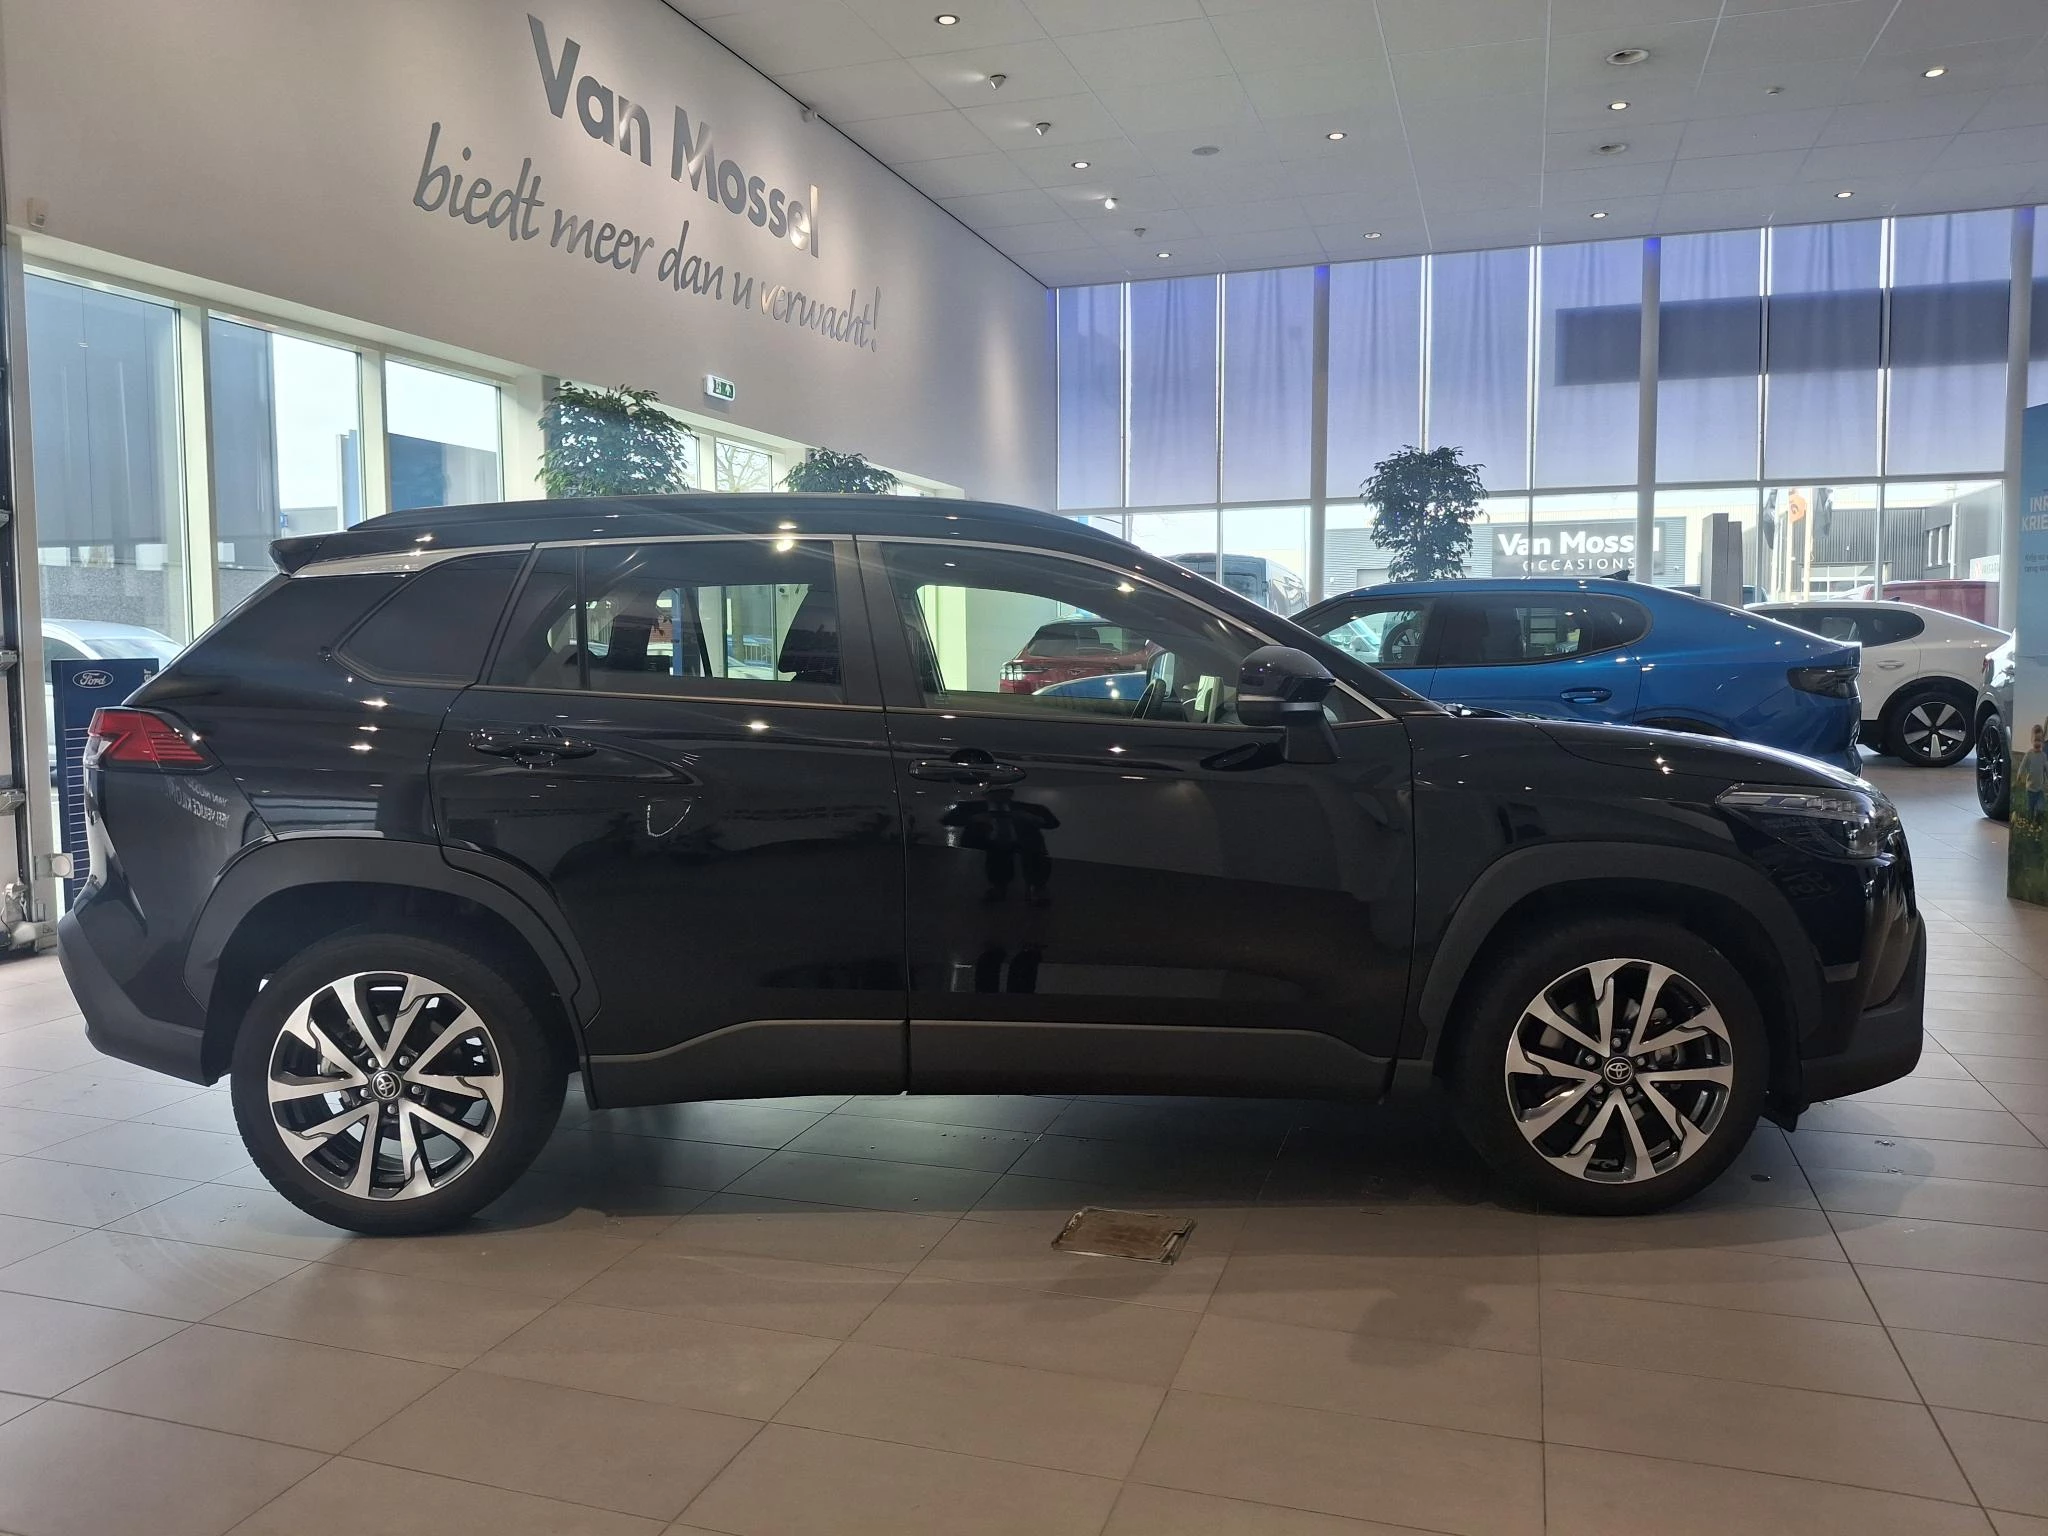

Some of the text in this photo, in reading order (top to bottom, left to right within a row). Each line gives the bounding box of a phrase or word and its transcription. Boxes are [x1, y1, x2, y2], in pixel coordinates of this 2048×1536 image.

[527, 13, 819, 258] Van Mossel
[413, 122, 881, 352] biedt meer dan u verwacht!
[1497, 526, 1660, 556] Van Mossl
[1523, 558, 1635, 572] OCCASIONS
[79, 672, 107, 685] Ford
